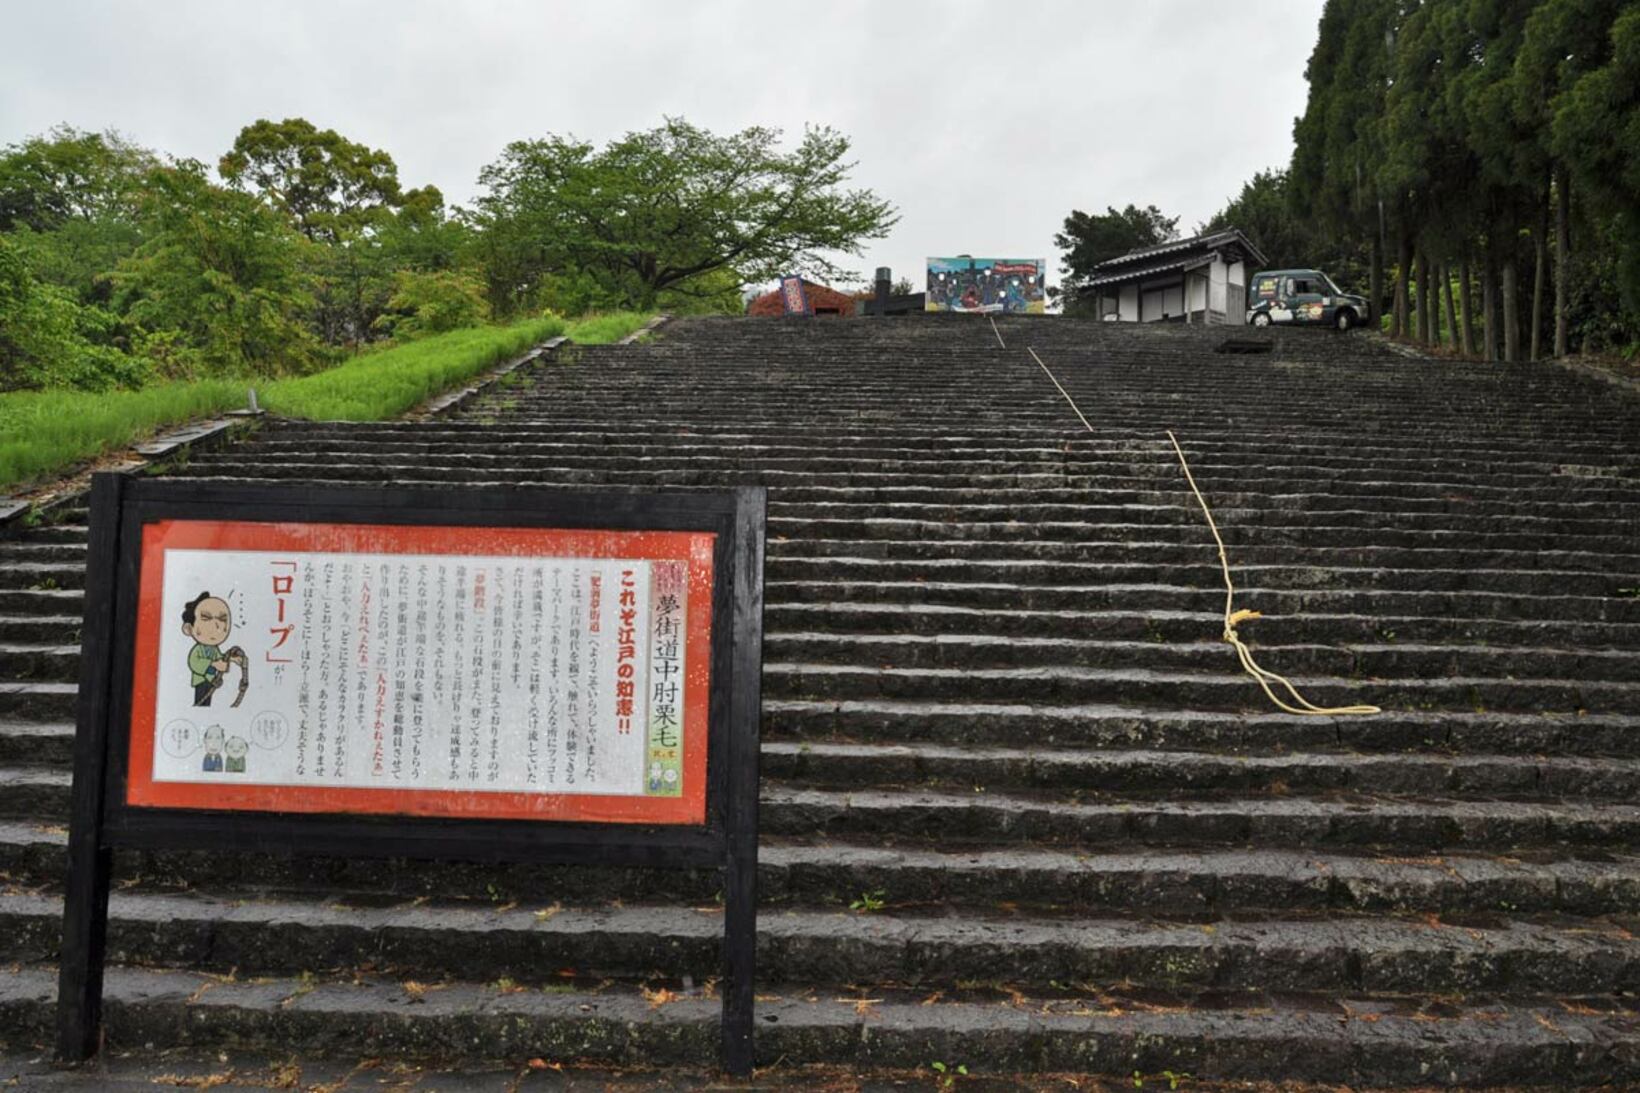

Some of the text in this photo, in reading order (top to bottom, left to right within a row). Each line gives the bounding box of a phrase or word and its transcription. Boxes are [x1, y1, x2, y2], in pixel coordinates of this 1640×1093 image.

[616, 570, 636, 735] これぞ江戸の知恵!!
